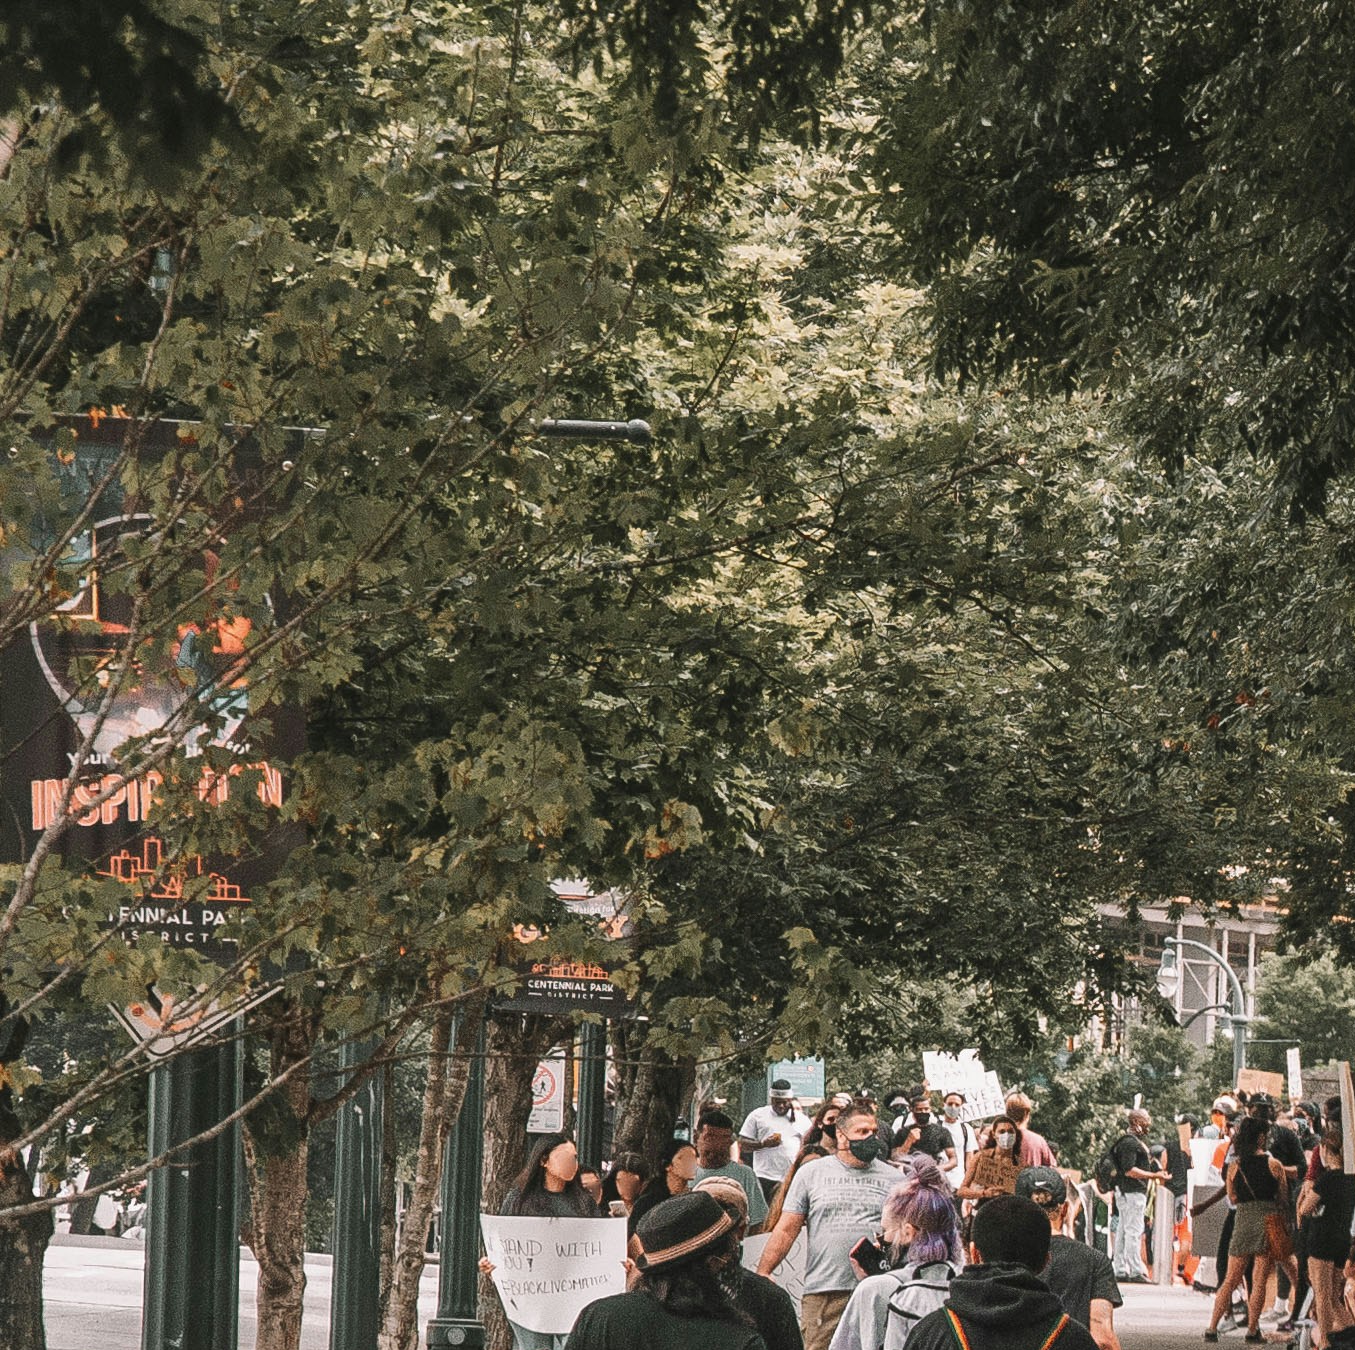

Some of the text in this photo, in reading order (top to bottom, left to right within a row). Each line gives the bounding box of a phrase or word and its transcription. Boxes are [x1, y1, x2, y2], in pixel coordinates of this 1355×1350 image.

[31, 760, 283, 831] INSPIRTIN
[121, 930, 209, 943] ISRICT
[527, 980, 614, 993] CENTENNIAL PARK
[547, 991, 595, 1000] DISTRICT
[555, 1240, 602, 1258] WITH
